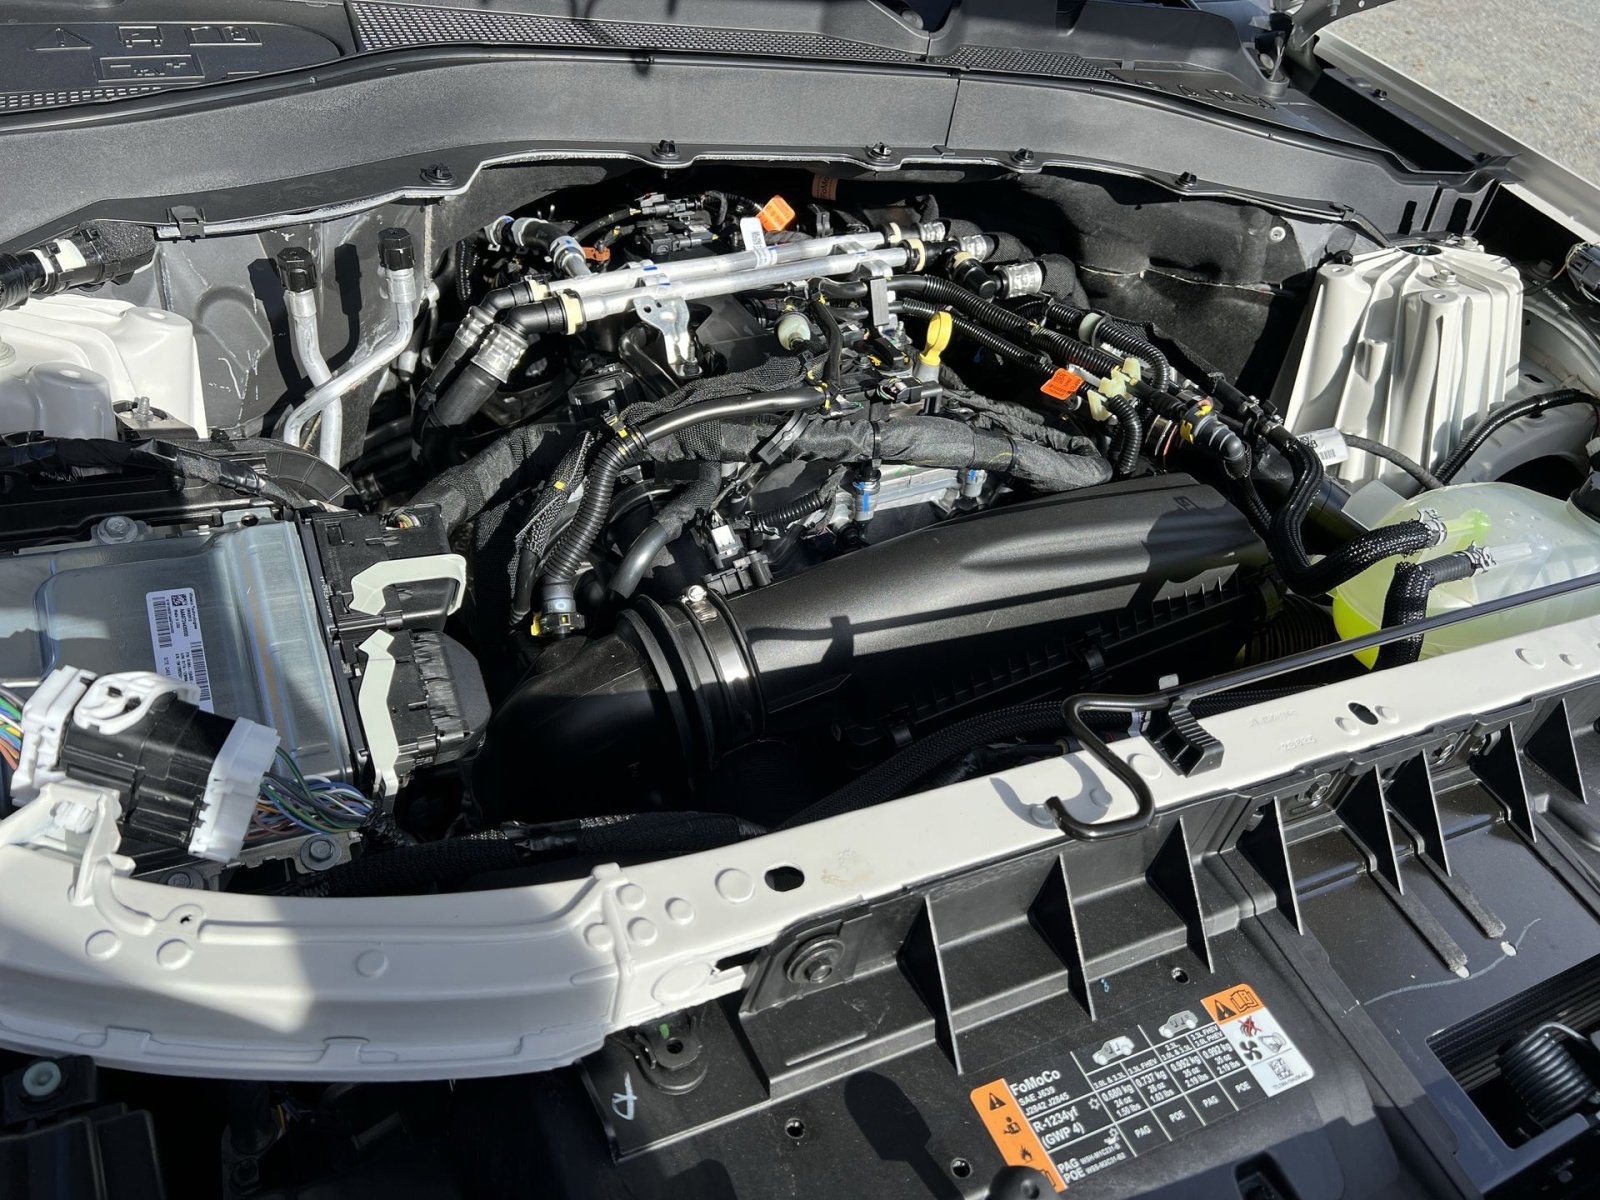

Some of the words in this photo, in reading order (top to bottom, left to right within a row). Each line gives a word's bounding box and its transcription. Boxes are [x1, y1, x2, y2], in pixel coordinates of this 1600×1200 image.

[1221, 1043, 1233, 1052] kg
[1189, 1055, 1201, 1065] kg
[1009, 1070, 1061, 1097] FoMoCo
[1135, 1073, 1155, 1088] 0.737
[1154, 1070, 1168, 1080] kg
[1234, 1081, 1251, 1093] POE
[1018, 1093, 1037, 1106] SAE
[1037, 1086, 1056, 1099] J639
[1121, 1084, 1135, 1094] kg
[1026, 1101, 1048, 1116] J2842
[1048, 1092, 1070, 1107] J2845
[1202, 1095, 1219, 1108] PAG
[1032, 1106, 1080, 1133] R-1234yf
[1168, 1110, 1186, 1123] POE
[1041, 1127, 1071, 1149] (GWP
[1072, 1122, 1086, 1135] 4)
[1134, 1125, 1152, 1138] PAG
[1057, 1158, 1080, 1174] PAG
[1063, 1167, 1086, 1183] POE
